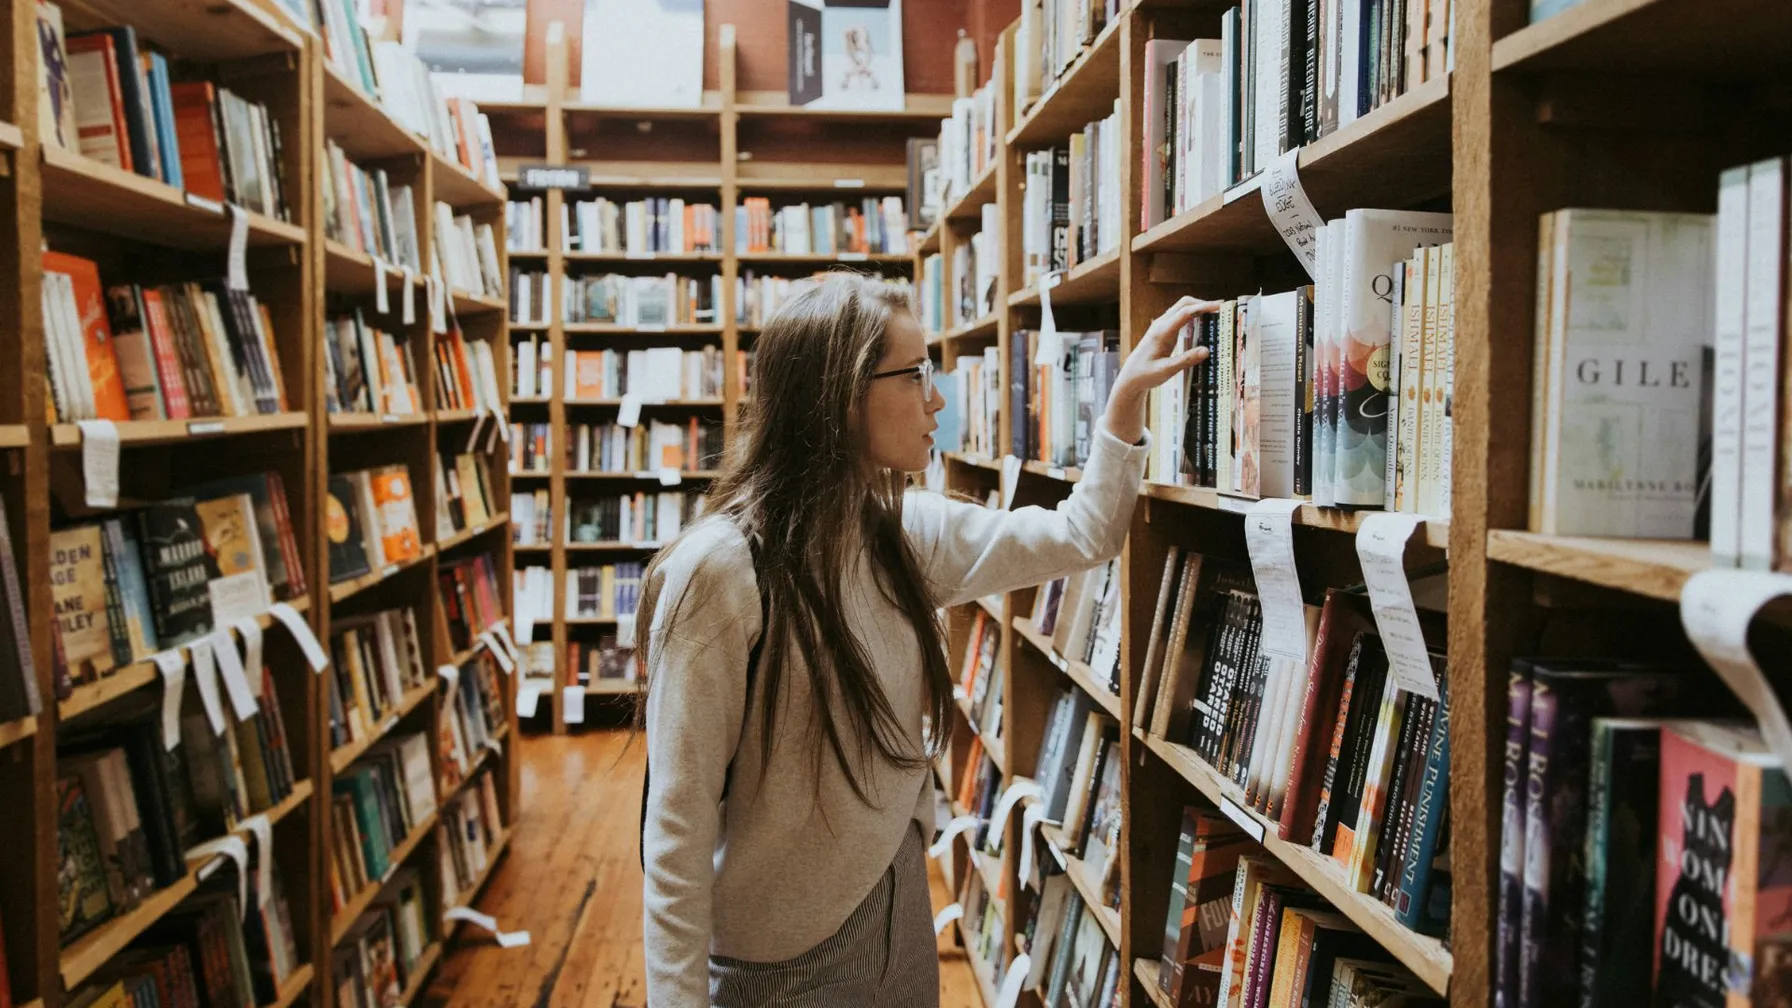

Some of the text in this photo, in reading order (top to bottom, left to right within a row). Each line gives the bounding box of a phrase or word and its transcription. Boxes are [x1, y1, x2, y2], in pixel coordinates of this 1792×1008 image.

[1305, 49, 1315, 102] BLEEDING
[1304, 105, 1313, 134] EDGE
[1423, 305, 1435, 374] ISHMAEL
[1436, 303, 1448, 374] ISHMAEL
[1373, 360, 1390, 369] SIG
[1376, 371, 1390, 380] CO
[1577, 358, 1690, 389] GILE
[1404, 304, 1420, 477] ISHMAEL DANIEL QUINN
[1419, 447, 1428, 480] QUINN
[56, 543, 92, 565] DEN
[55, 595, 85, 614] ANE
[1310, 633, 1325, 666] Devil
[1308, 668, 1314, 677] in
[1209, 664, 1228, 732] OTARED
[1215, 668, 1235, 736] OTARED
[1297, 679, 1315, 736] Jerusalem
[1419, 702, 1427, 720] WHY
[1402, 711, 1416, 743] RAKHA
[1426, 706, 1434, 724] WHY
[1411, 730, 1421, 752] CAME
[1419, 733, 1429, 756] CAME
[1346, 764, 1356, 793] Childhood
[1354, 768, 1364, 798] Childhood
[1384, 779, 1401, 840] CROCODILES
[1397, 800, 1408, 825] MARY
[1405, 804, 1415, 830] MARY
[1404, 766, 1439, 885] PUNISHMENT
[1679, 800, 1730, 851] NIN
[1248, 906, 1263, 972] UNRESTORED
[1258, 915, 1271, 982] UNRESTORED
[1188, 984, 1216, 1006] AY
[1253, 986, 1261, 1008] WOM
